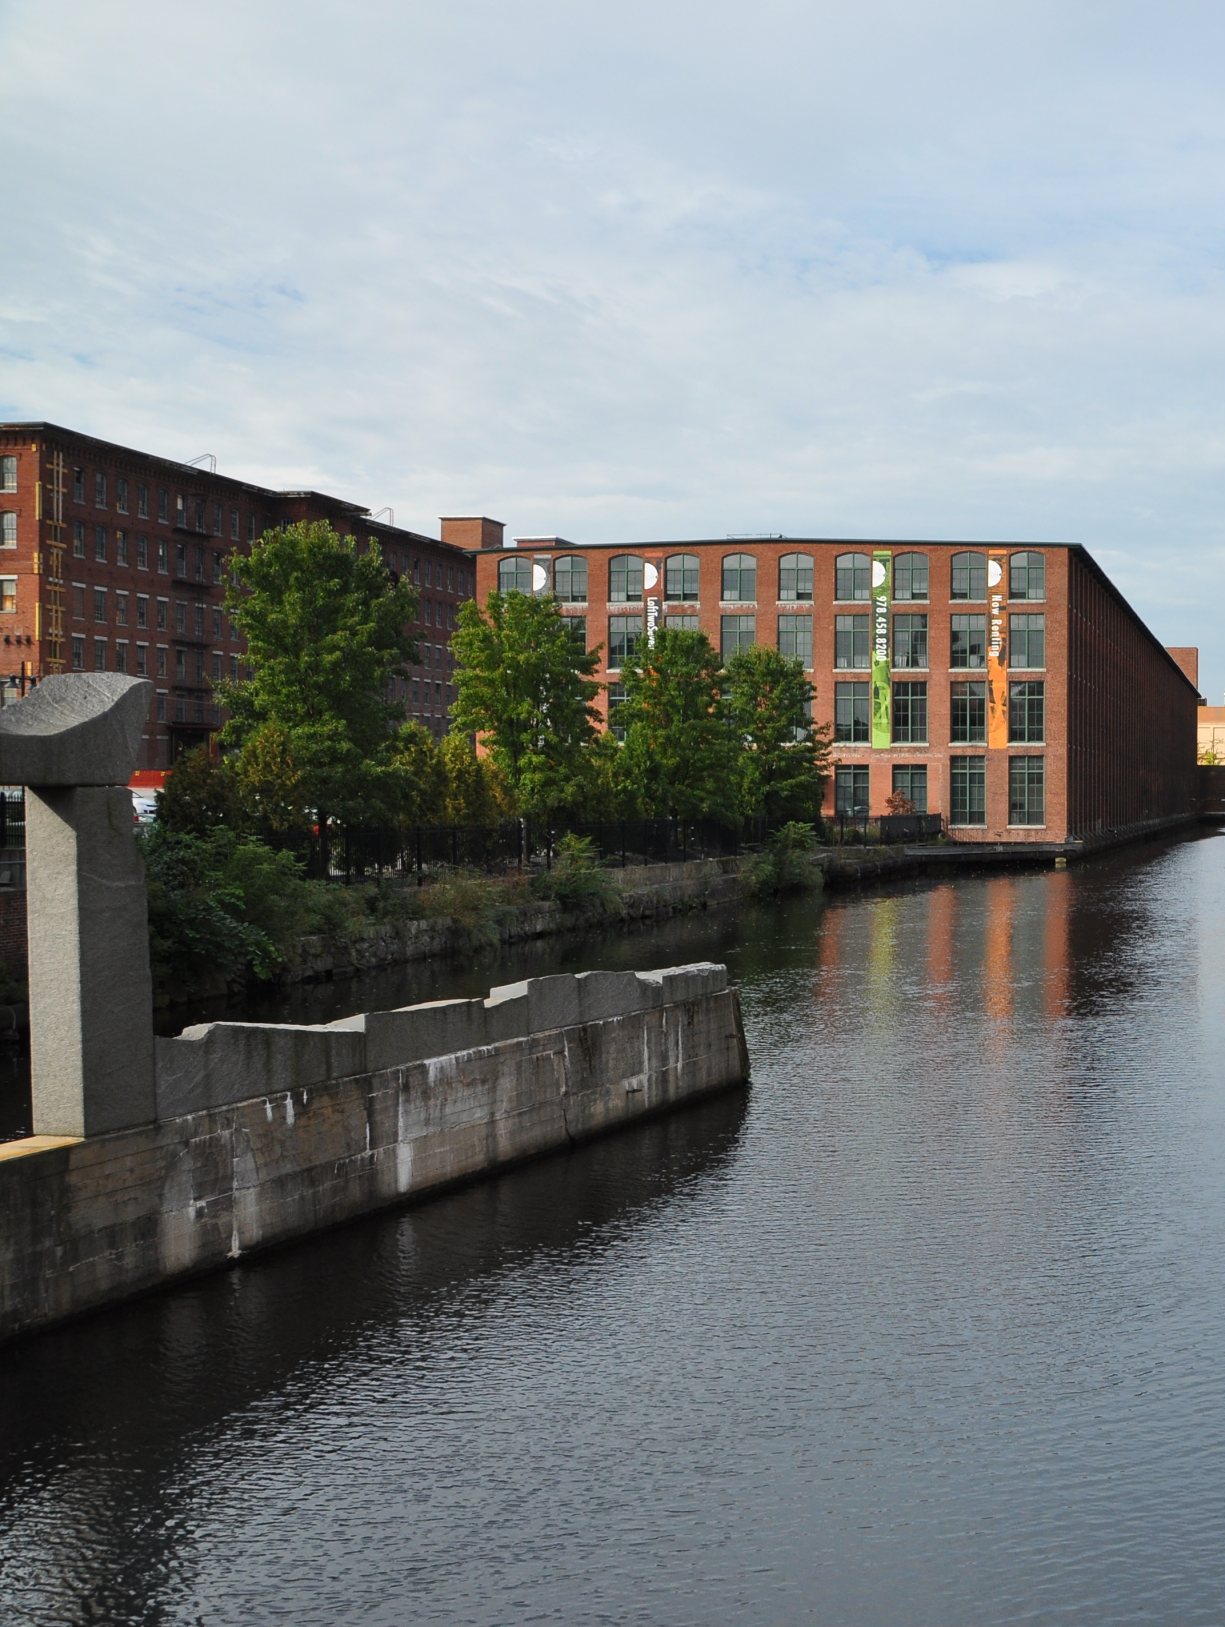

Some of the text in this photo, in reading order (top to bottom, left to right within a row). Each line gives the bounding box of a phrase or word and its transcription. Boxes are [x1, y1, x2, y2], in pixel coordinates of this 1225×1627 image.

[876, 595, 888, 662] 978.458.8200
[990, 595, 1003, 657] Now Renting
